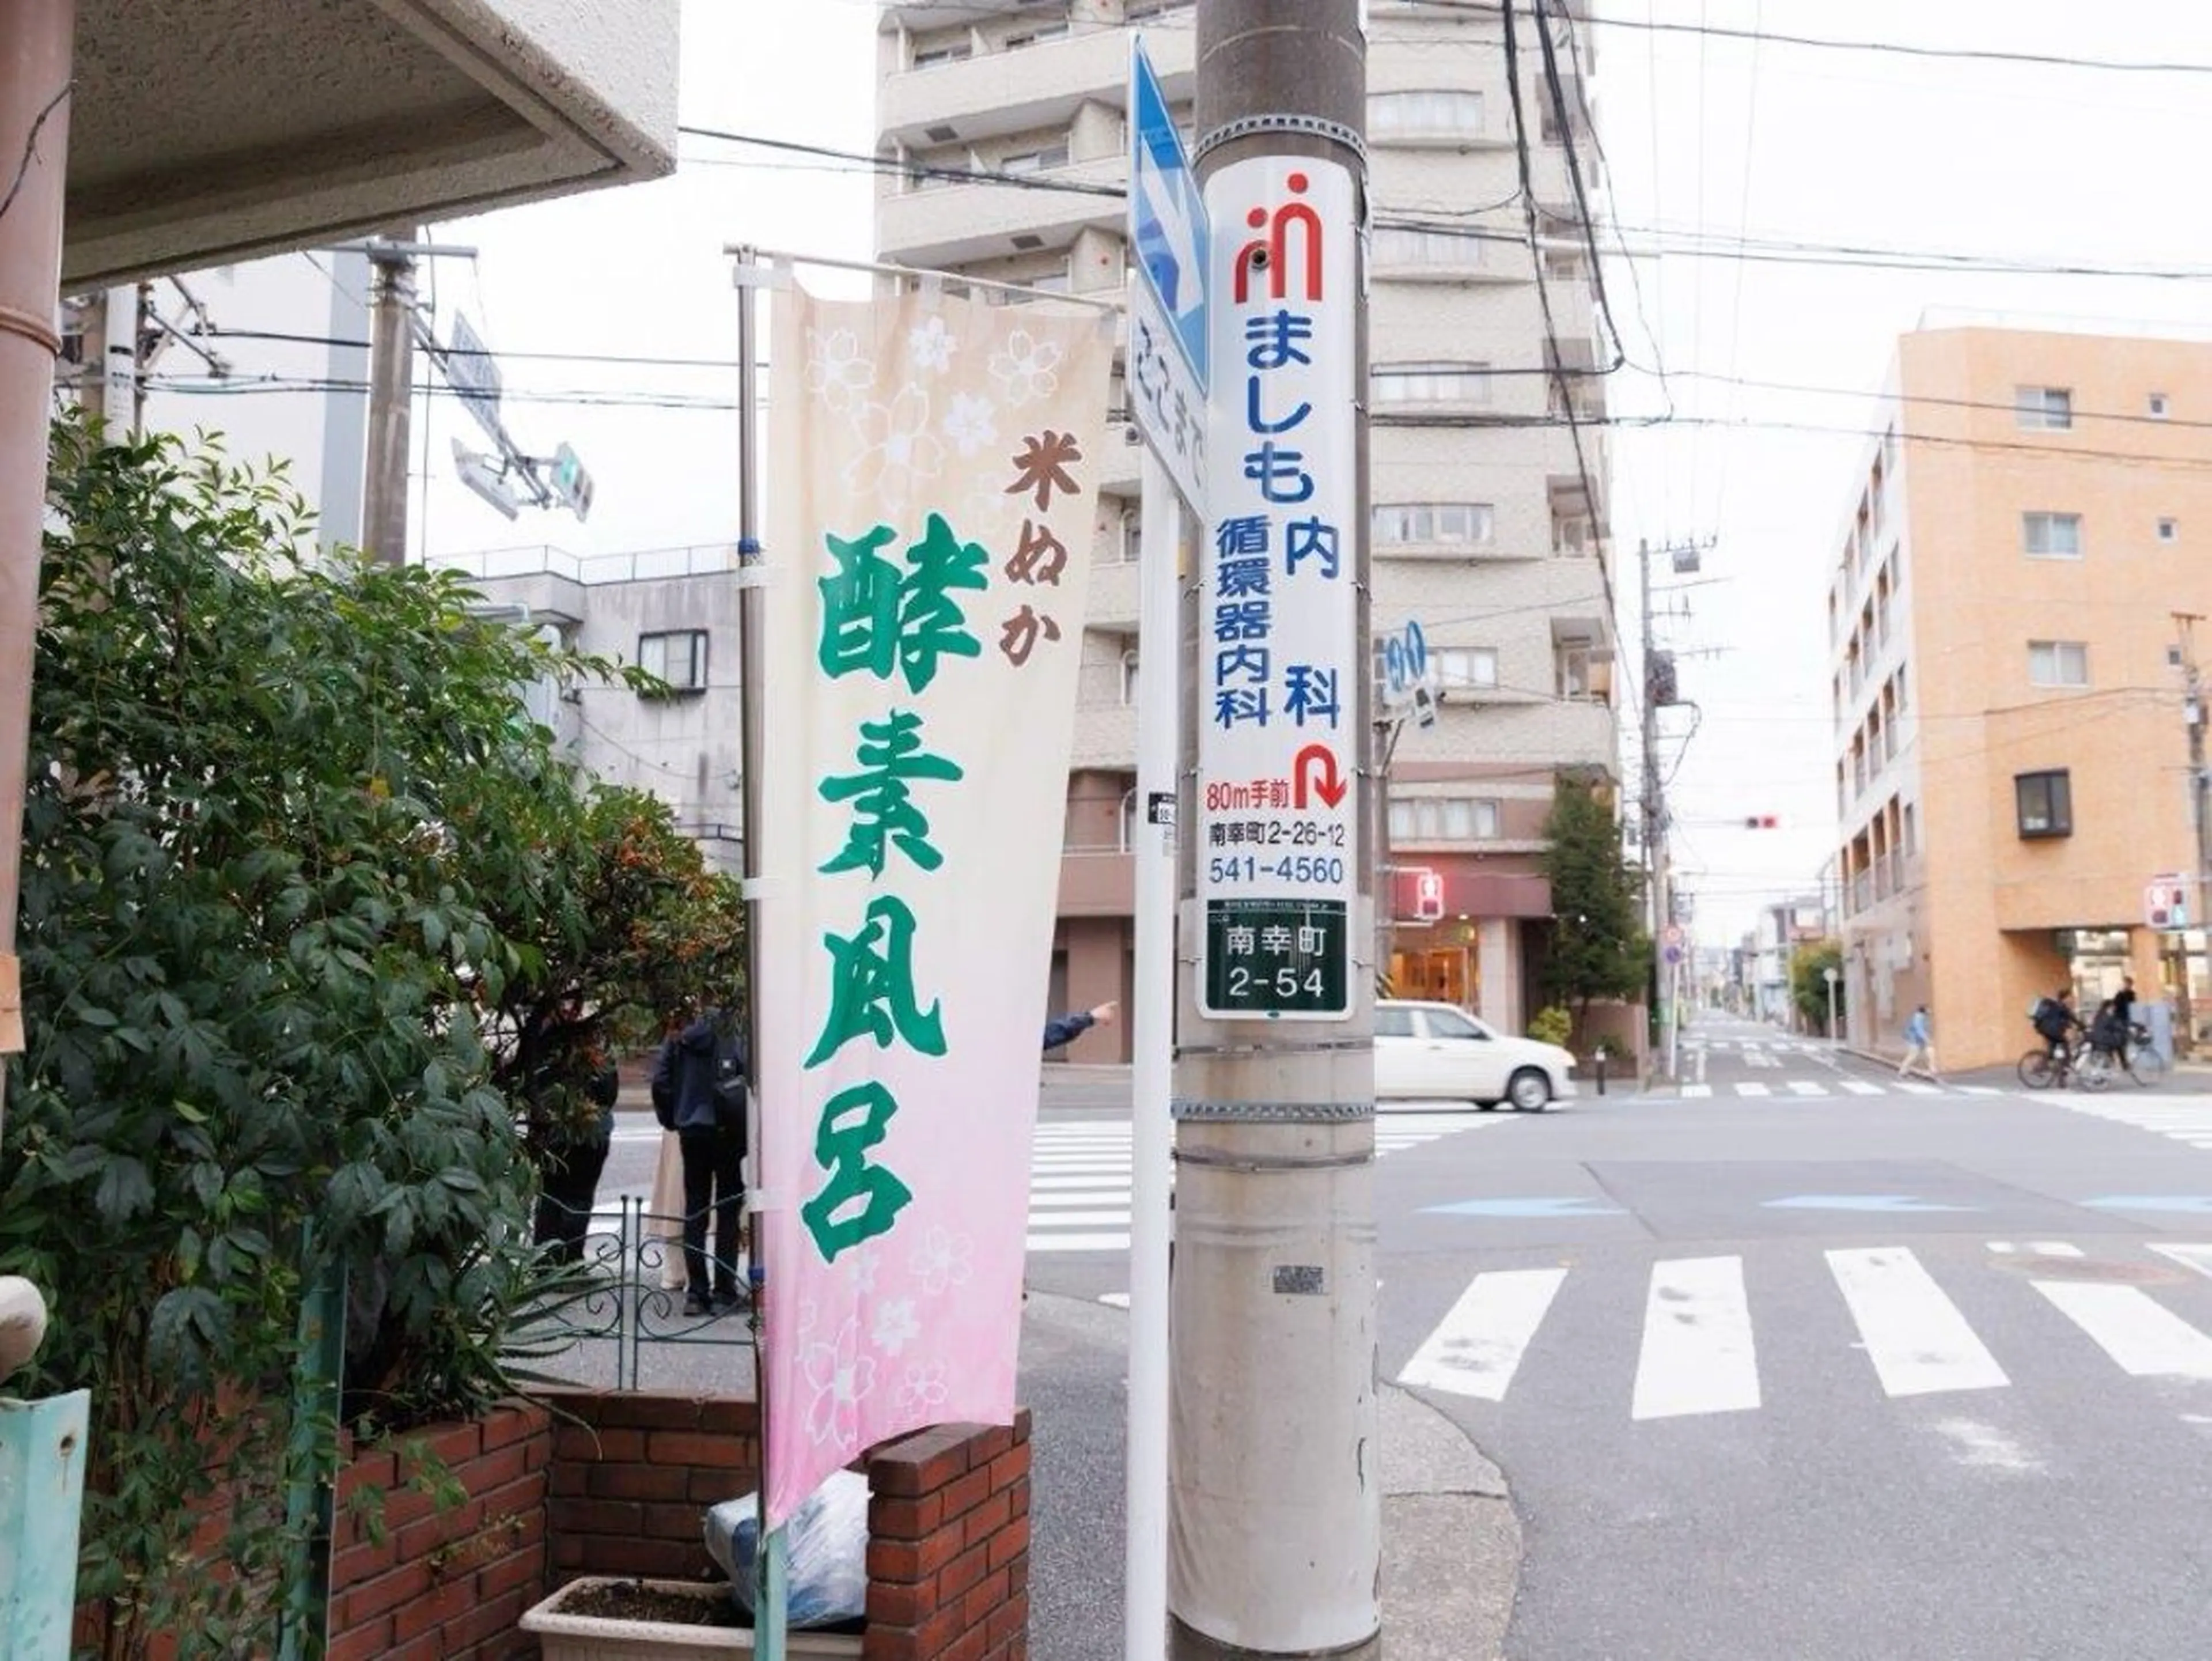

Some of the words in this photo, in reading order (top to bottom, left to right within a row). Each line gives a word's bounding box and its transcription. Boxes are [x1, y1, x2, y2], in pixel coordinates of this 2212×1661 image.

[999, 429, 1082, 667] 米ぬか
[1214, 514, 1272, 730] 循環器内科
[1206, 778, 1290, 811] 80m手前
[1209, 820, 1345, 847] 南幸町2-26-12
[1210, 856, 1343, 883] 541-4560
[801, 512, 990, 1263] 酵素風呂
[1226, 924, 1327, 957] 南幸町
[1228, 967, 1325, 998] 2-54
